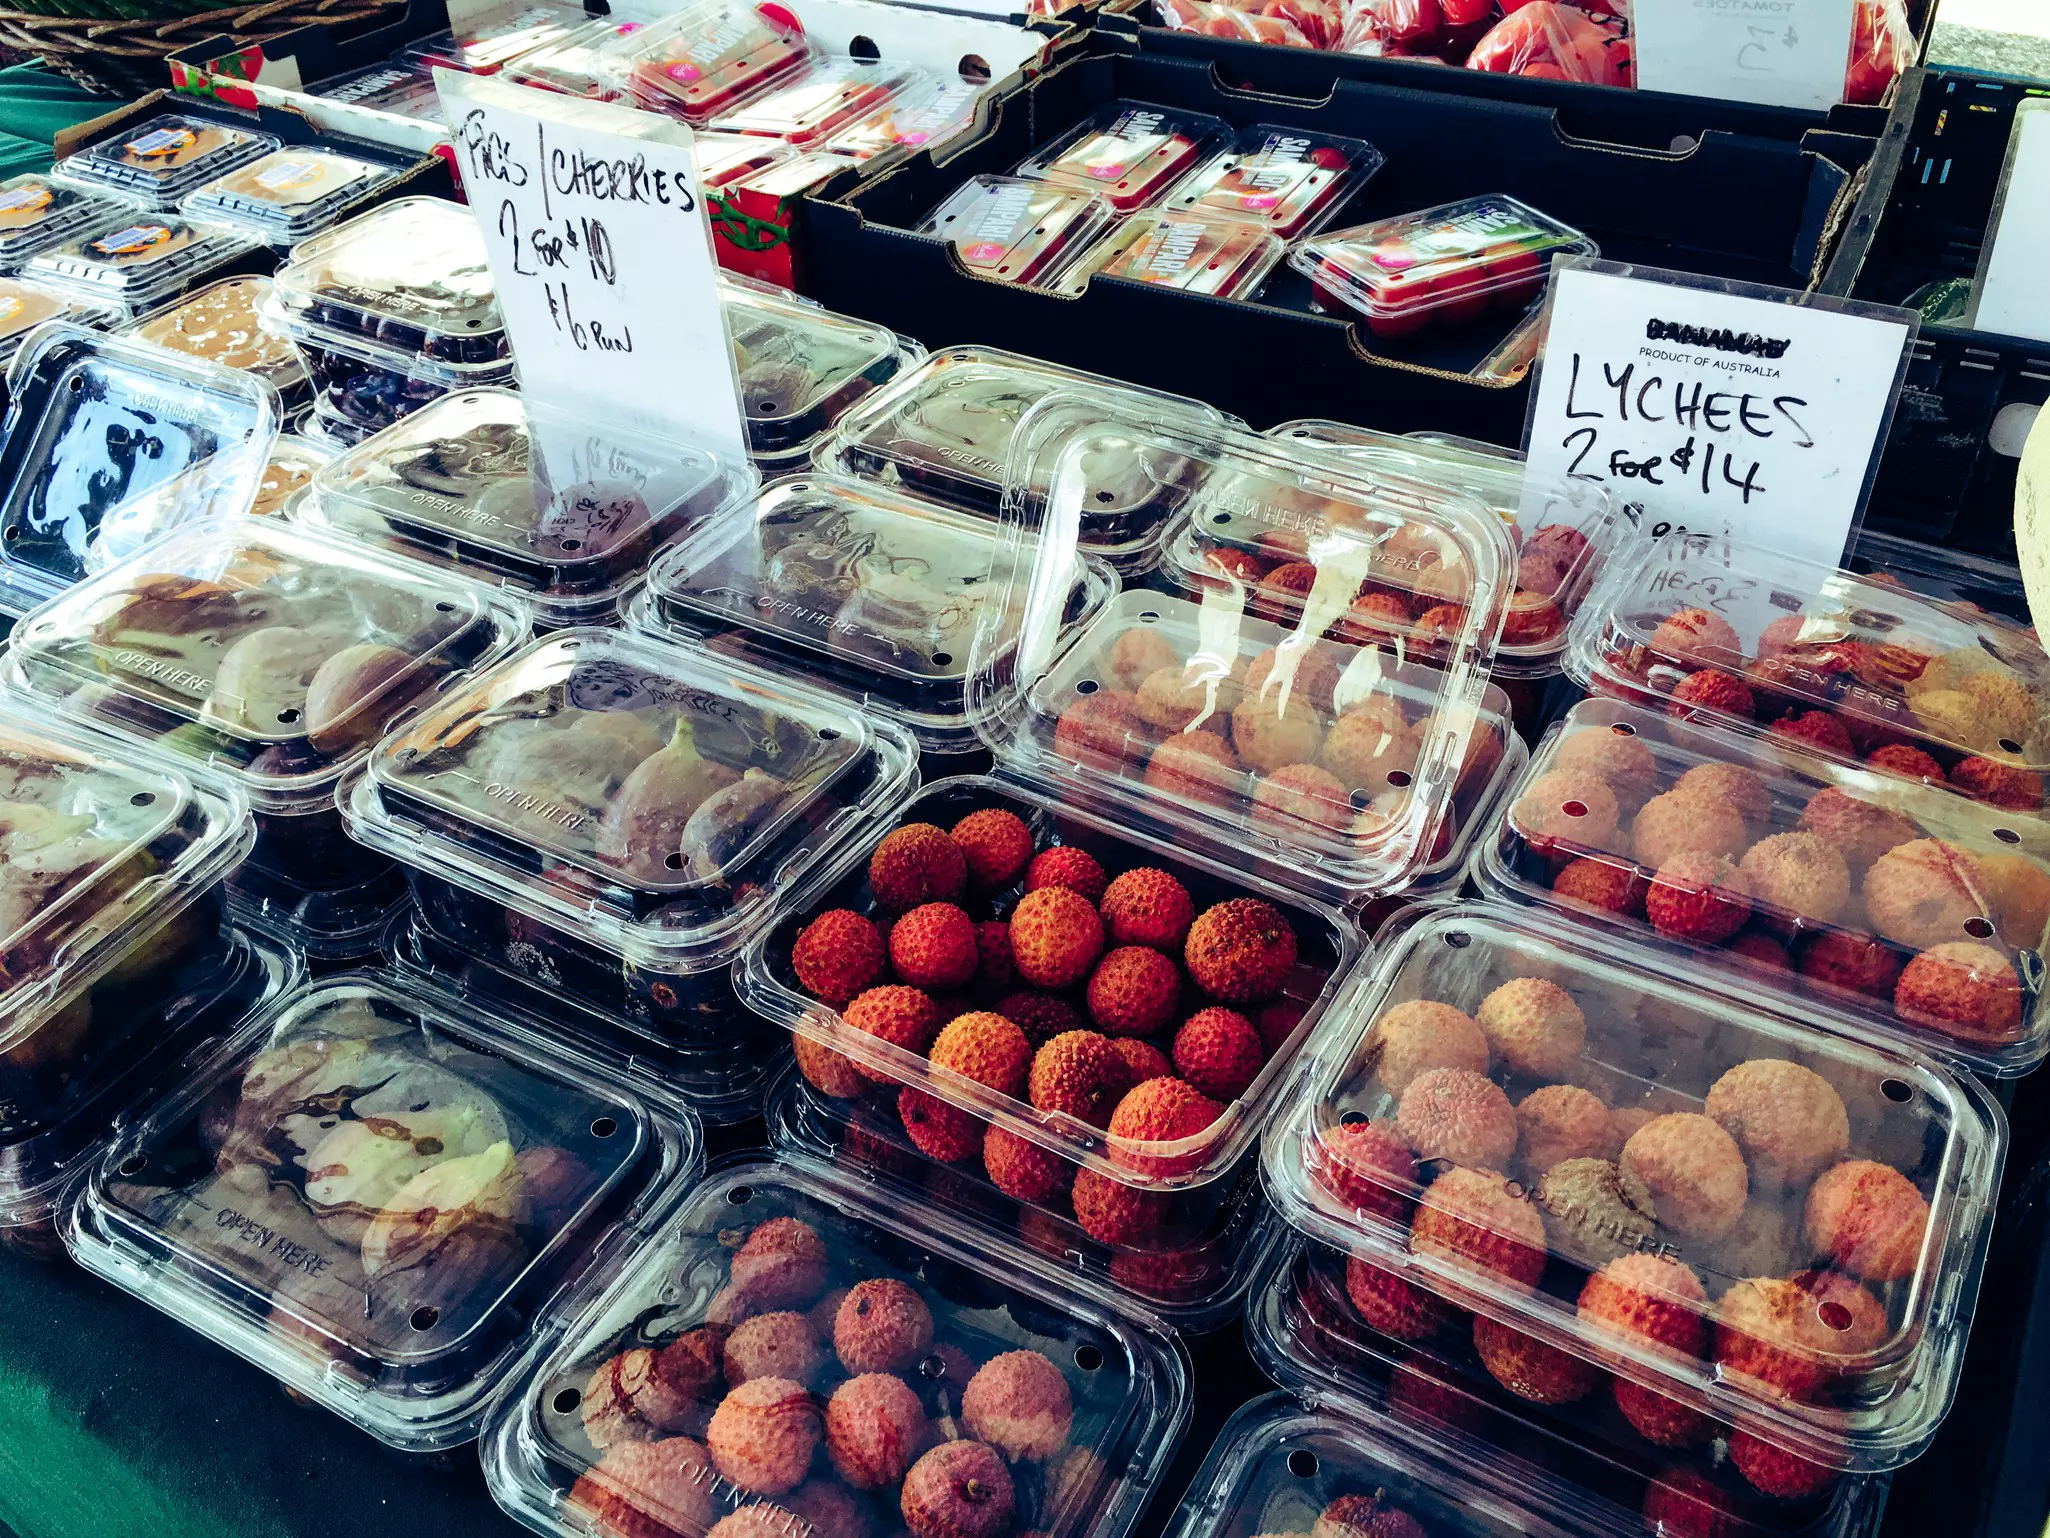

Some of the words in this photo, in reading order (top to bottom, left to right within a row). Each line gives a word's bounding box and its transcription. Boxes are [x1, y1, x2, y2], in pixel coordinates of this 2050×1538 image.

[499, 199, 538, 276] 2
[1639, 347, 1692, 363] PRODUCT
[1694, 357, 1711, 367] OF
[1712, 360, 1781, 378] AUSTRALIA
[1566, 353, 1815, 448] LYCHEES
[937, 447, 982, 466] OPEN
[983, 460, 1006, 474] HE
[1562, 427, 1605, 481] 2
[1669, 436, 1766, 504] $14
[410, 493, 456, 513] OPEN
[452, 505, 501, 526] HERE
[758, 596, 809, 619] OPEN
[807, 611, 860, 636] HERE
[115, 651, 165, 674] OPEN
[160, 667, 213, 692] HERE
[1763, 658, 1829, 686] OPEN
[1832, 681, 1900, 711] HERE
[484, 782, 539, 810] OPEN
[535, 802, 593, 832] HERE
[214, 1207, 275, 1249] OPEN
[267, 1236, 333, 1279] HERE
[1504, 1179, 1588, 1227] OPEN
[1594, 1215, 1682, 1266] HERE
[679, 1458, 750, 1508] OPEN
